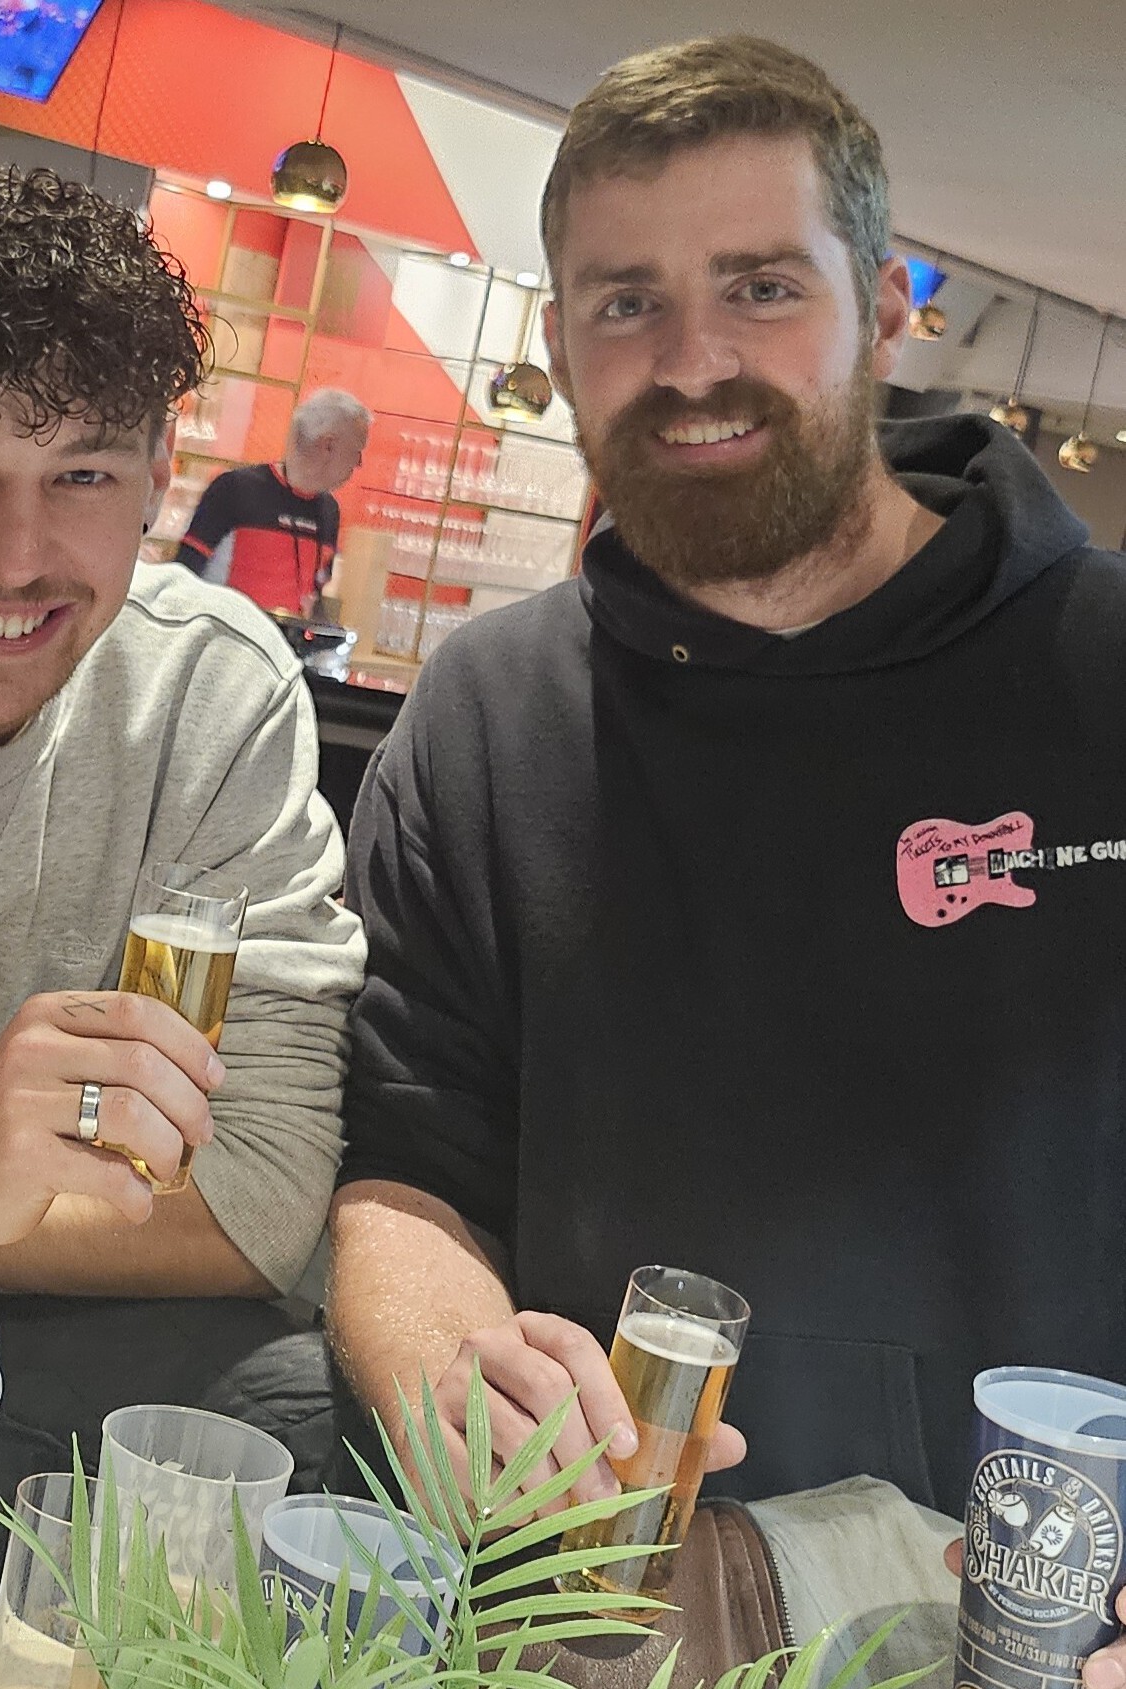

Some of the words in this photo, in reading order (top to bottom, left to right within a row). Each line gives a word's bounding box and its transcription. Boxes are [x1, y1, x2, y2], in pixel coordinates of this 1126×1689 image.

[975, 1458, 1056, 1502] COCKTAILS
[1081, 1498, 1116, 1570] DRINKS
[966, 1524, 1114, 1626] SHAKER
[1033, 1605, 1068, 1618] RICARD
